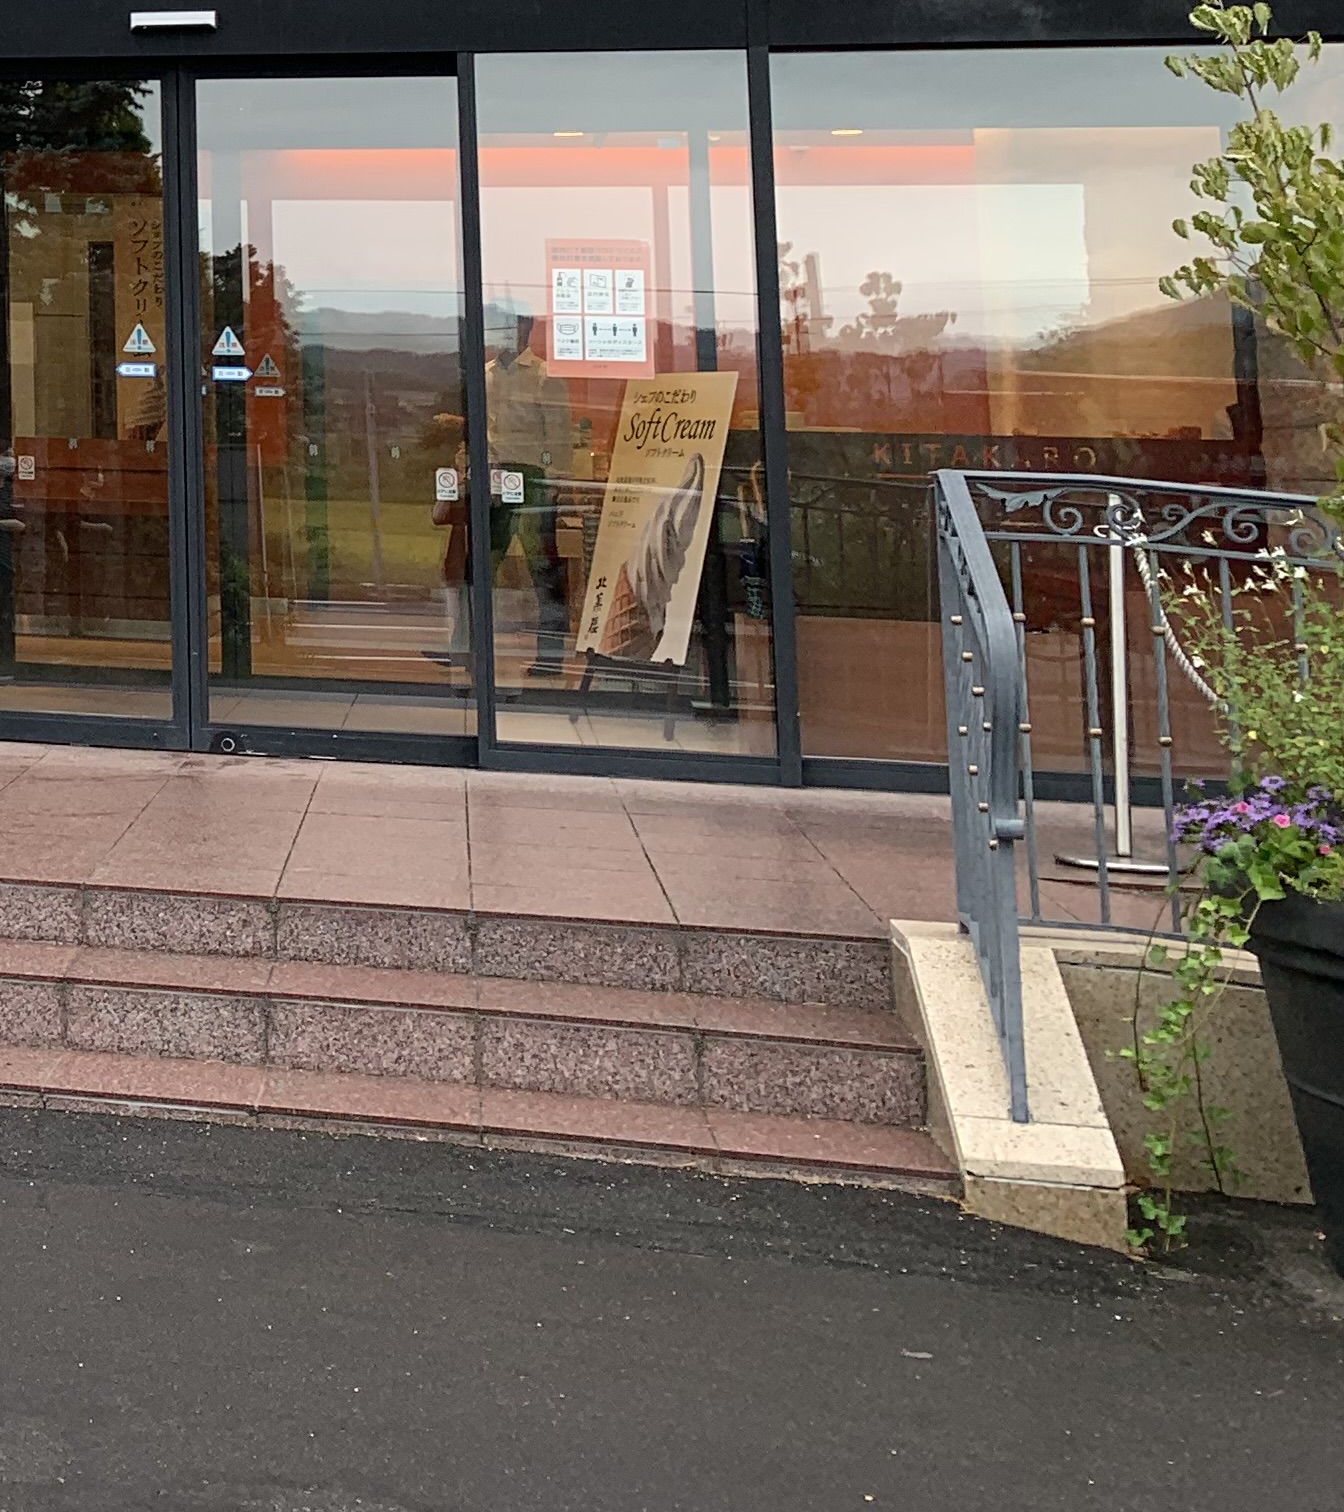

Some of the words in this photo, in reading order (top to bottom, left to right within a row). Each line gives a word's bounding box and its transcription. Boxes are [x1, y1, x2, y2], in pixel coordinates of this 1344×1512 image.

[632, 389, 697, 404] シェフのこだわり
[623, 407, 661, 450] Soft
[661, 411, 717, 444] Cream
[872, 442, 1097, 468] KITAKRO
